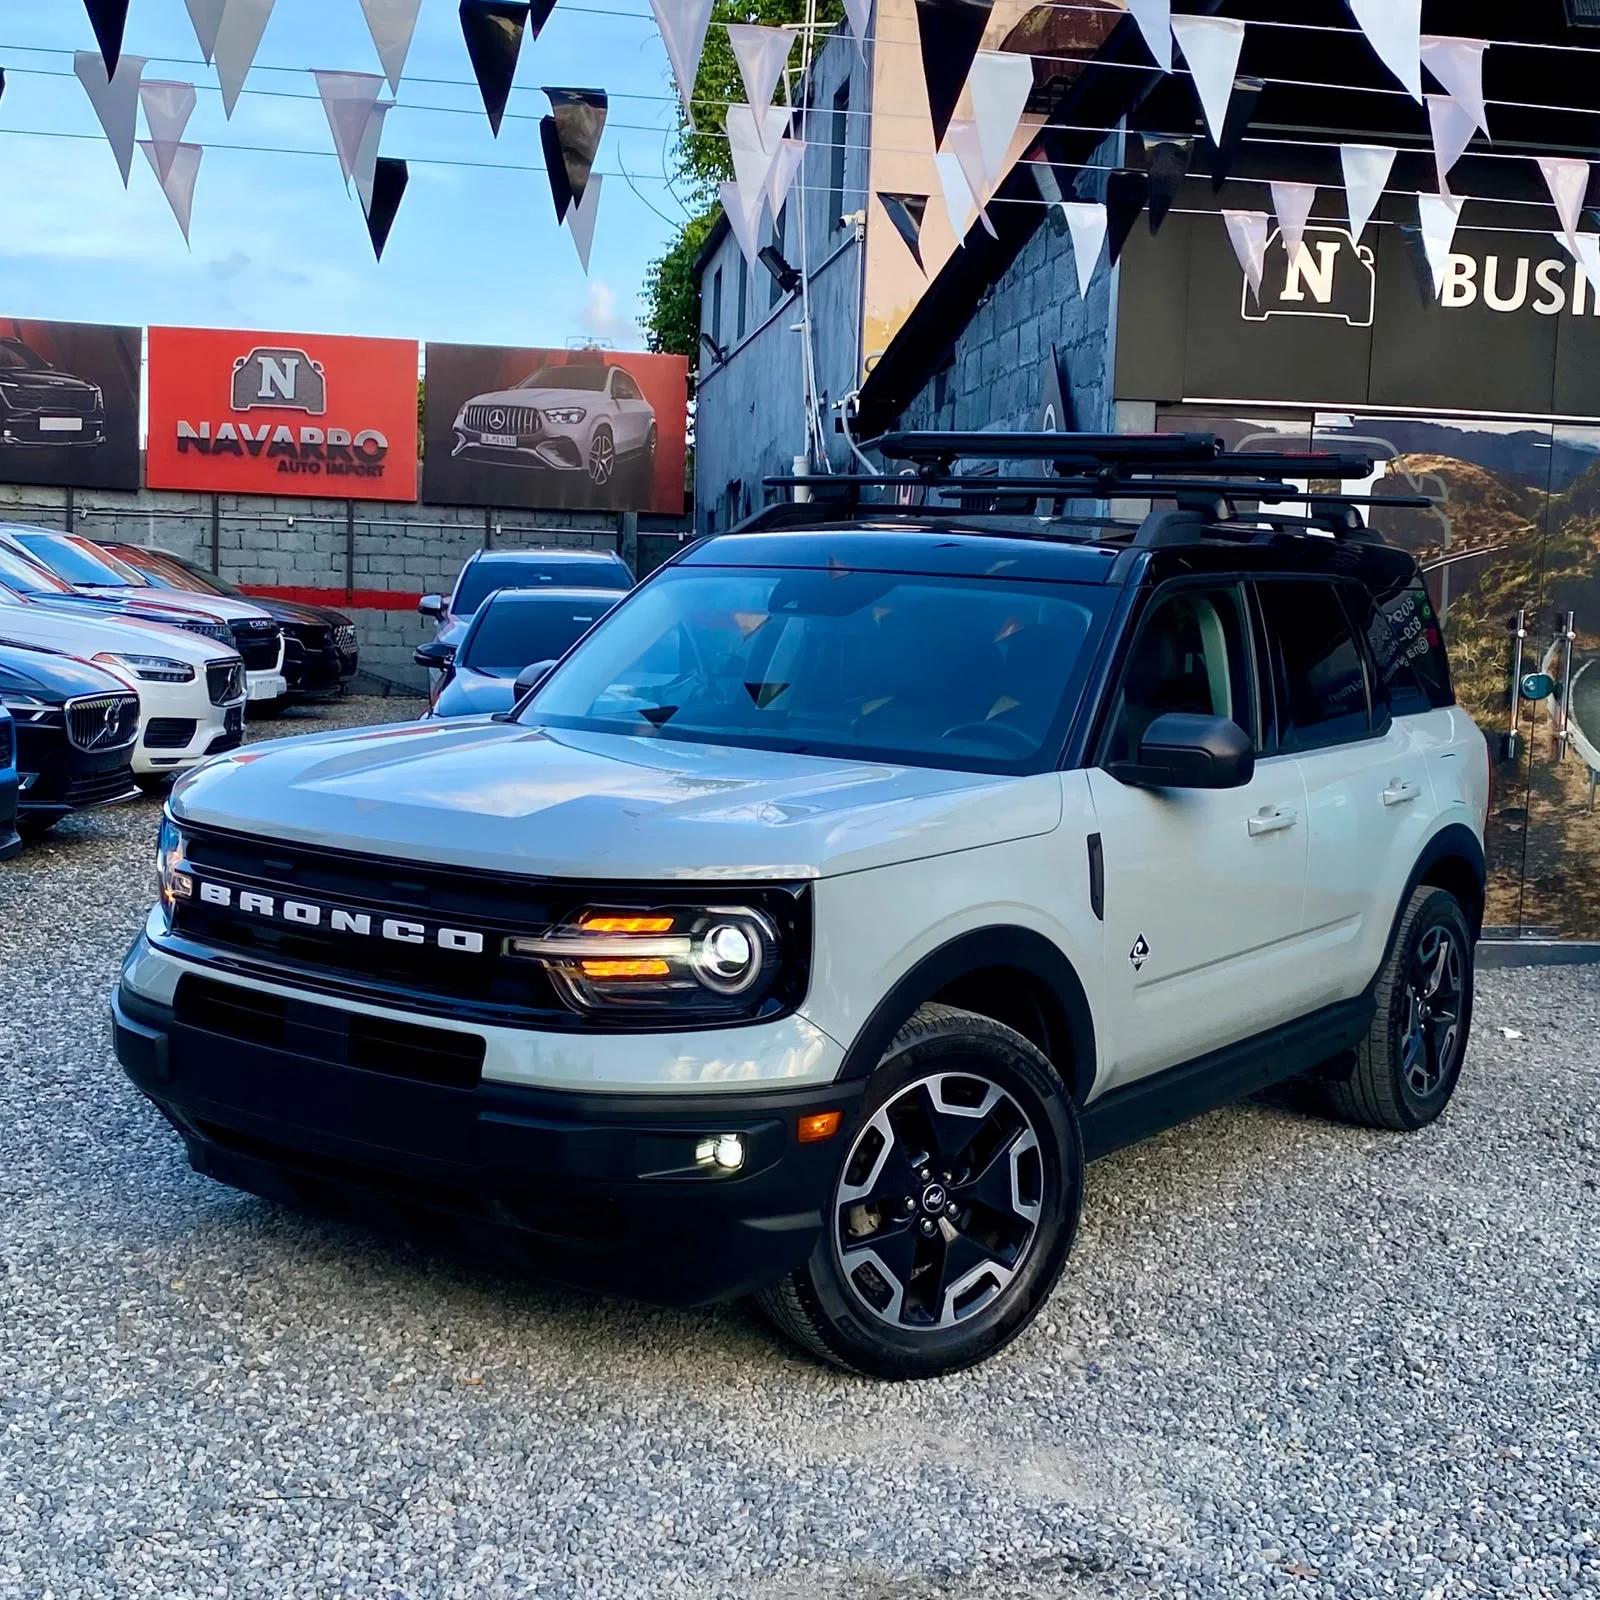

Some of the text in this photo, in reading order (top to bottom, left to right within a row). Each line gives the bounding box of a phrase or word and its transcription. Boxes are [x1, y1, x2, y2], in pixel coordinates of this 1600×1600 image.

[1279, 240, 1341, 303] N
[1441, 252, 1600, 317] BUSI
[257, 356, 299, 399] N
[176, 420, 389, 465] NAVARRO
[277, 460, 385, 478] AUTO IMPORT
[200, 882, 484, 954] BRONCO
